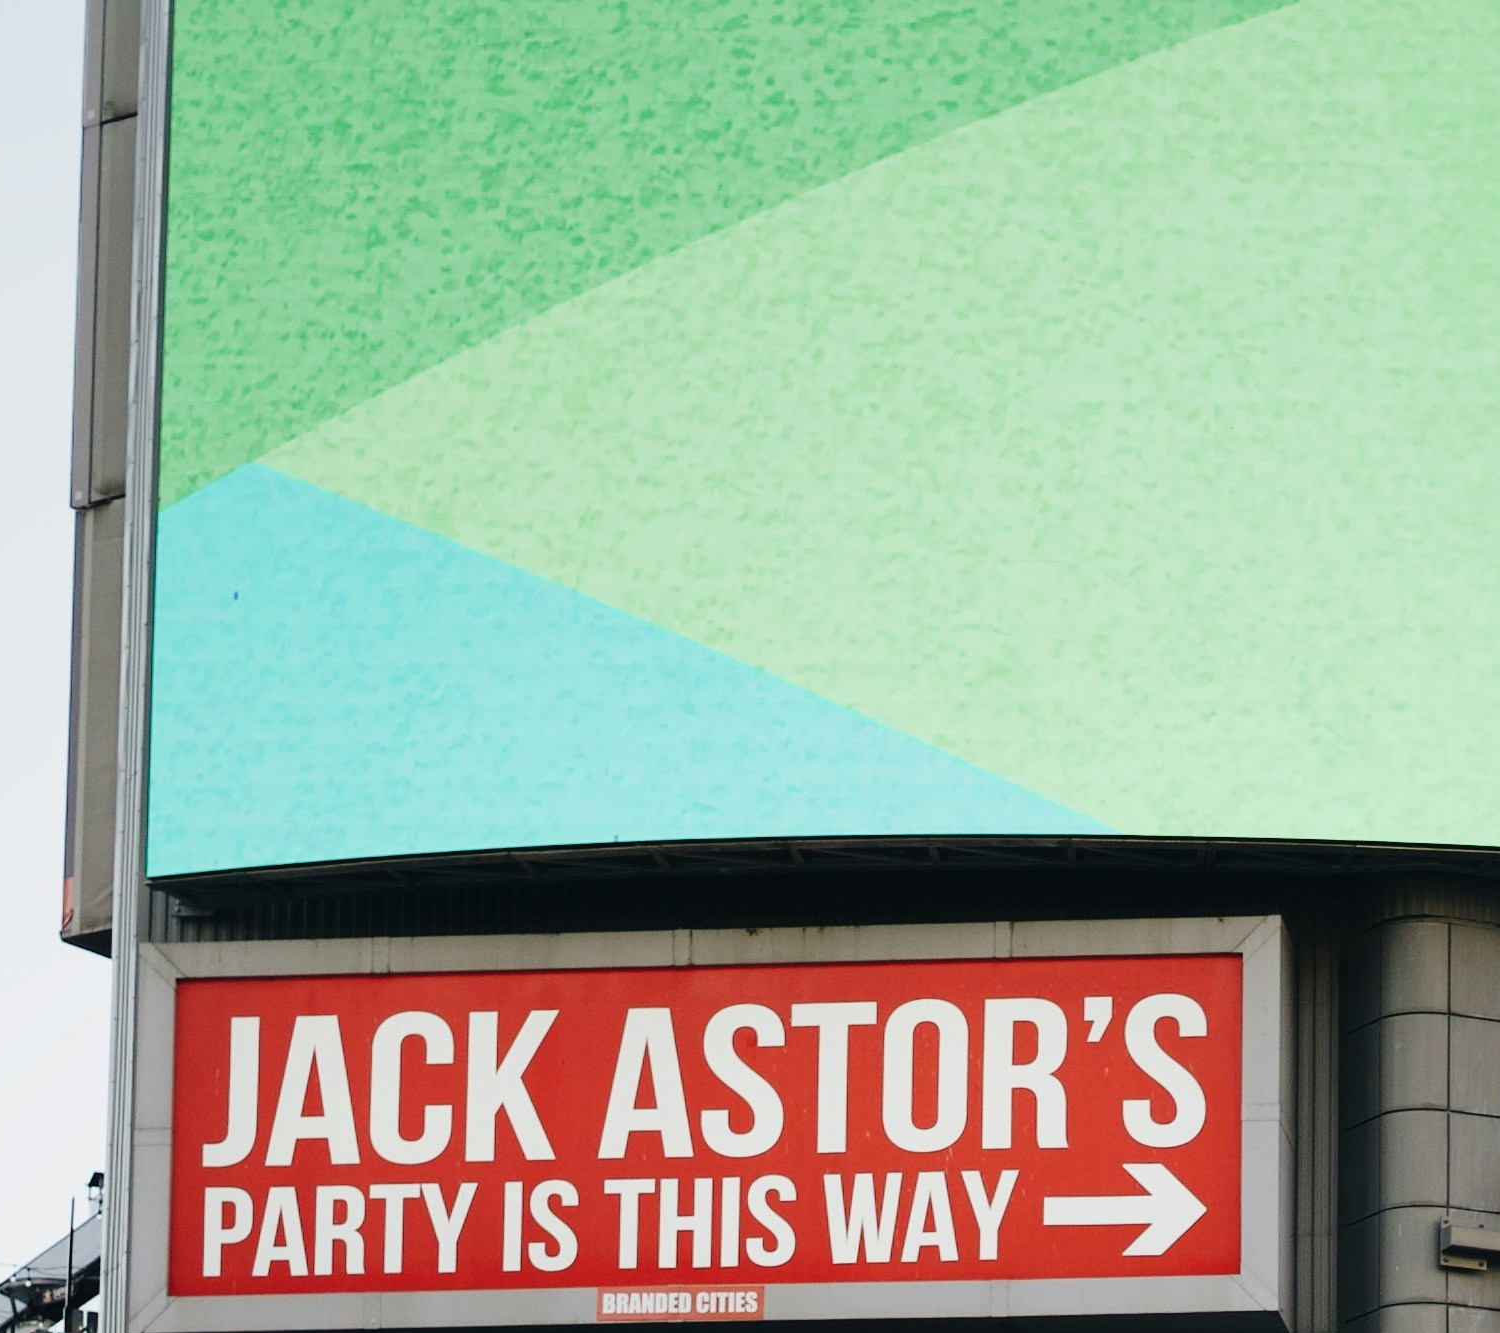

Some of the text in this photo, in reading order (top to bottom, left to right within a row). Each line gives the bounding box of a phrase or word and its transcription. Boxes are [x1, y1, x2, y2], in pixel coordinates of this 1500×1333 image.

[202, 993, 1209, 1168] JACK ASTOR'S
[201, 1168, 1020, 1278] PARTY IS THIS WAY
[602, 1291, 758, 1314] BRANDED CITIES
